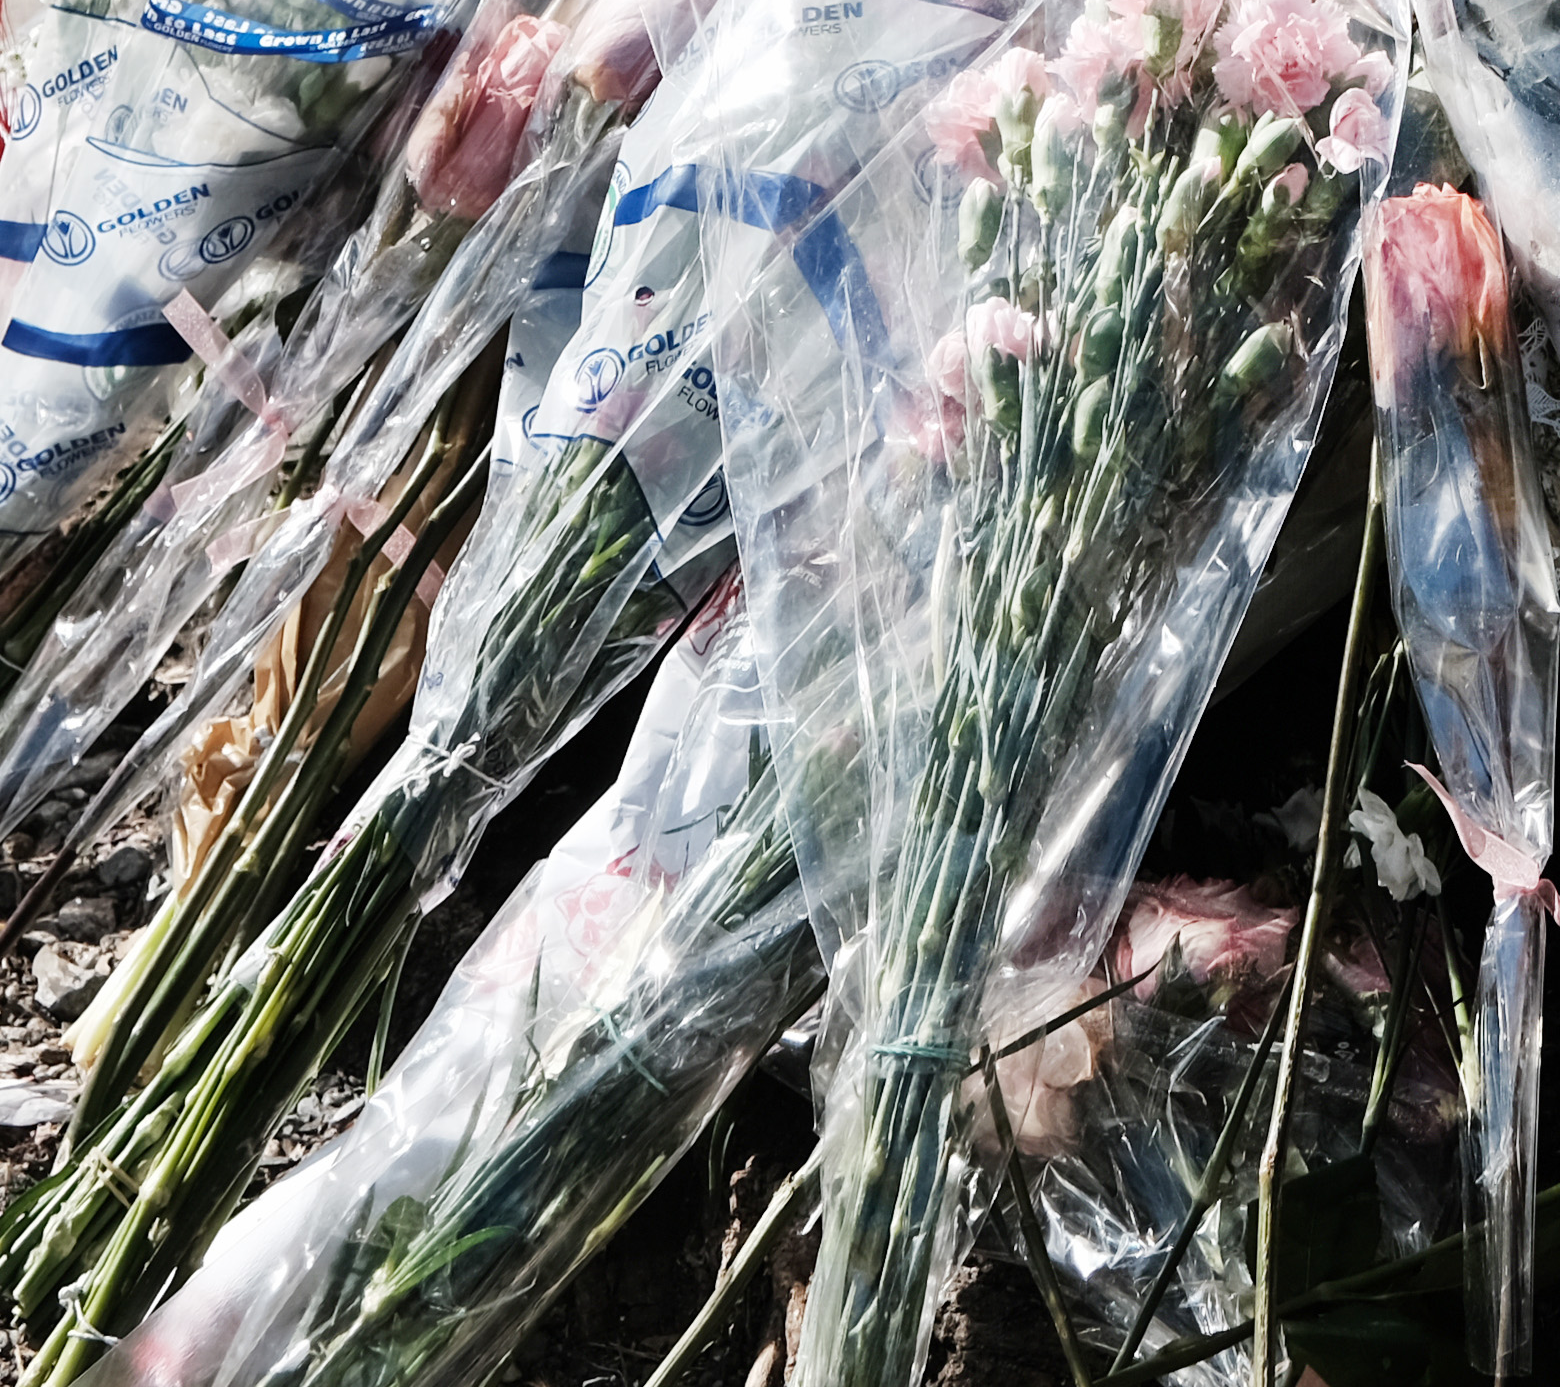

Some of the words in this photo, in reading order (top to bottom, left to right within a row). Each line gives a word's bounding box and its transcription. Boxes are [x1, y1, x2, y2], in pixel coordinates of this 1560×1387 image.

[153, 23, 200, 43] GOLDEN
[173, 15, 188, 30] to
[191, 19, 237, 46] Last
[259, 28, 322, 49] Grown
[351, 22, 388, 40] Last
[42, 45, 119, 100] GOLDEN
[96, 183, 211, 235] GOLDEN
[677, 387, 720, 425] FLOW
[16, 422, 127, 472] GOLDEN
